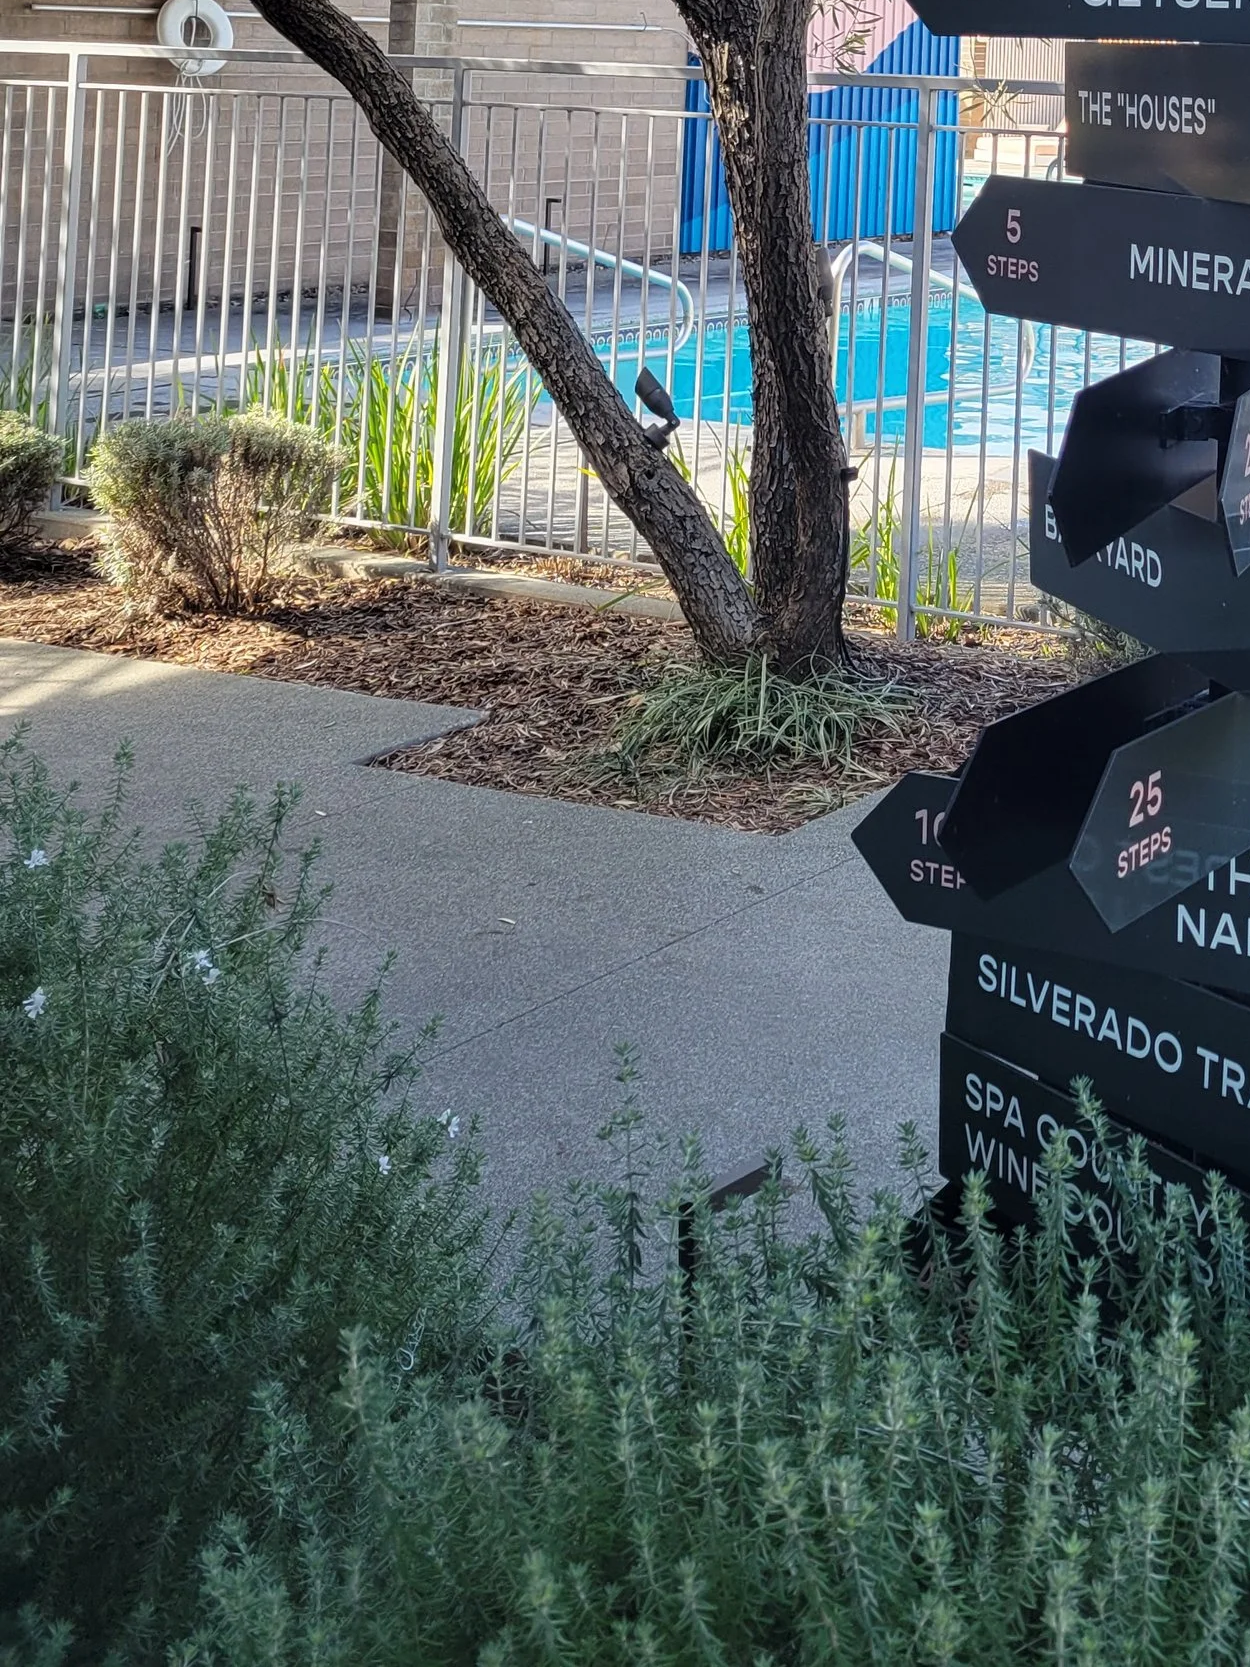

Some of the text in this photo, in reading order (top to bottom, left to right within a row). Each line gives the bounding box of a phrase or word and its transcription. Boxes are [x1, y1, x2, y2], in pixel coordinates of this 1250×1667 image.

[1079, 90, 1216, 135] THE "HOUSES"
[1006, 208, 1021, 244] 5
[986, 255, 1039, 283] STEPS
[1045, 504, 1162, 588] BYARD
[1129, 771, 1162, 827] 25
[1117, 827, 1172, 878] STEPS
[978, 953, 1182, 1074] SILVERADO
[965, 1072, 1026, 1138] SPA
